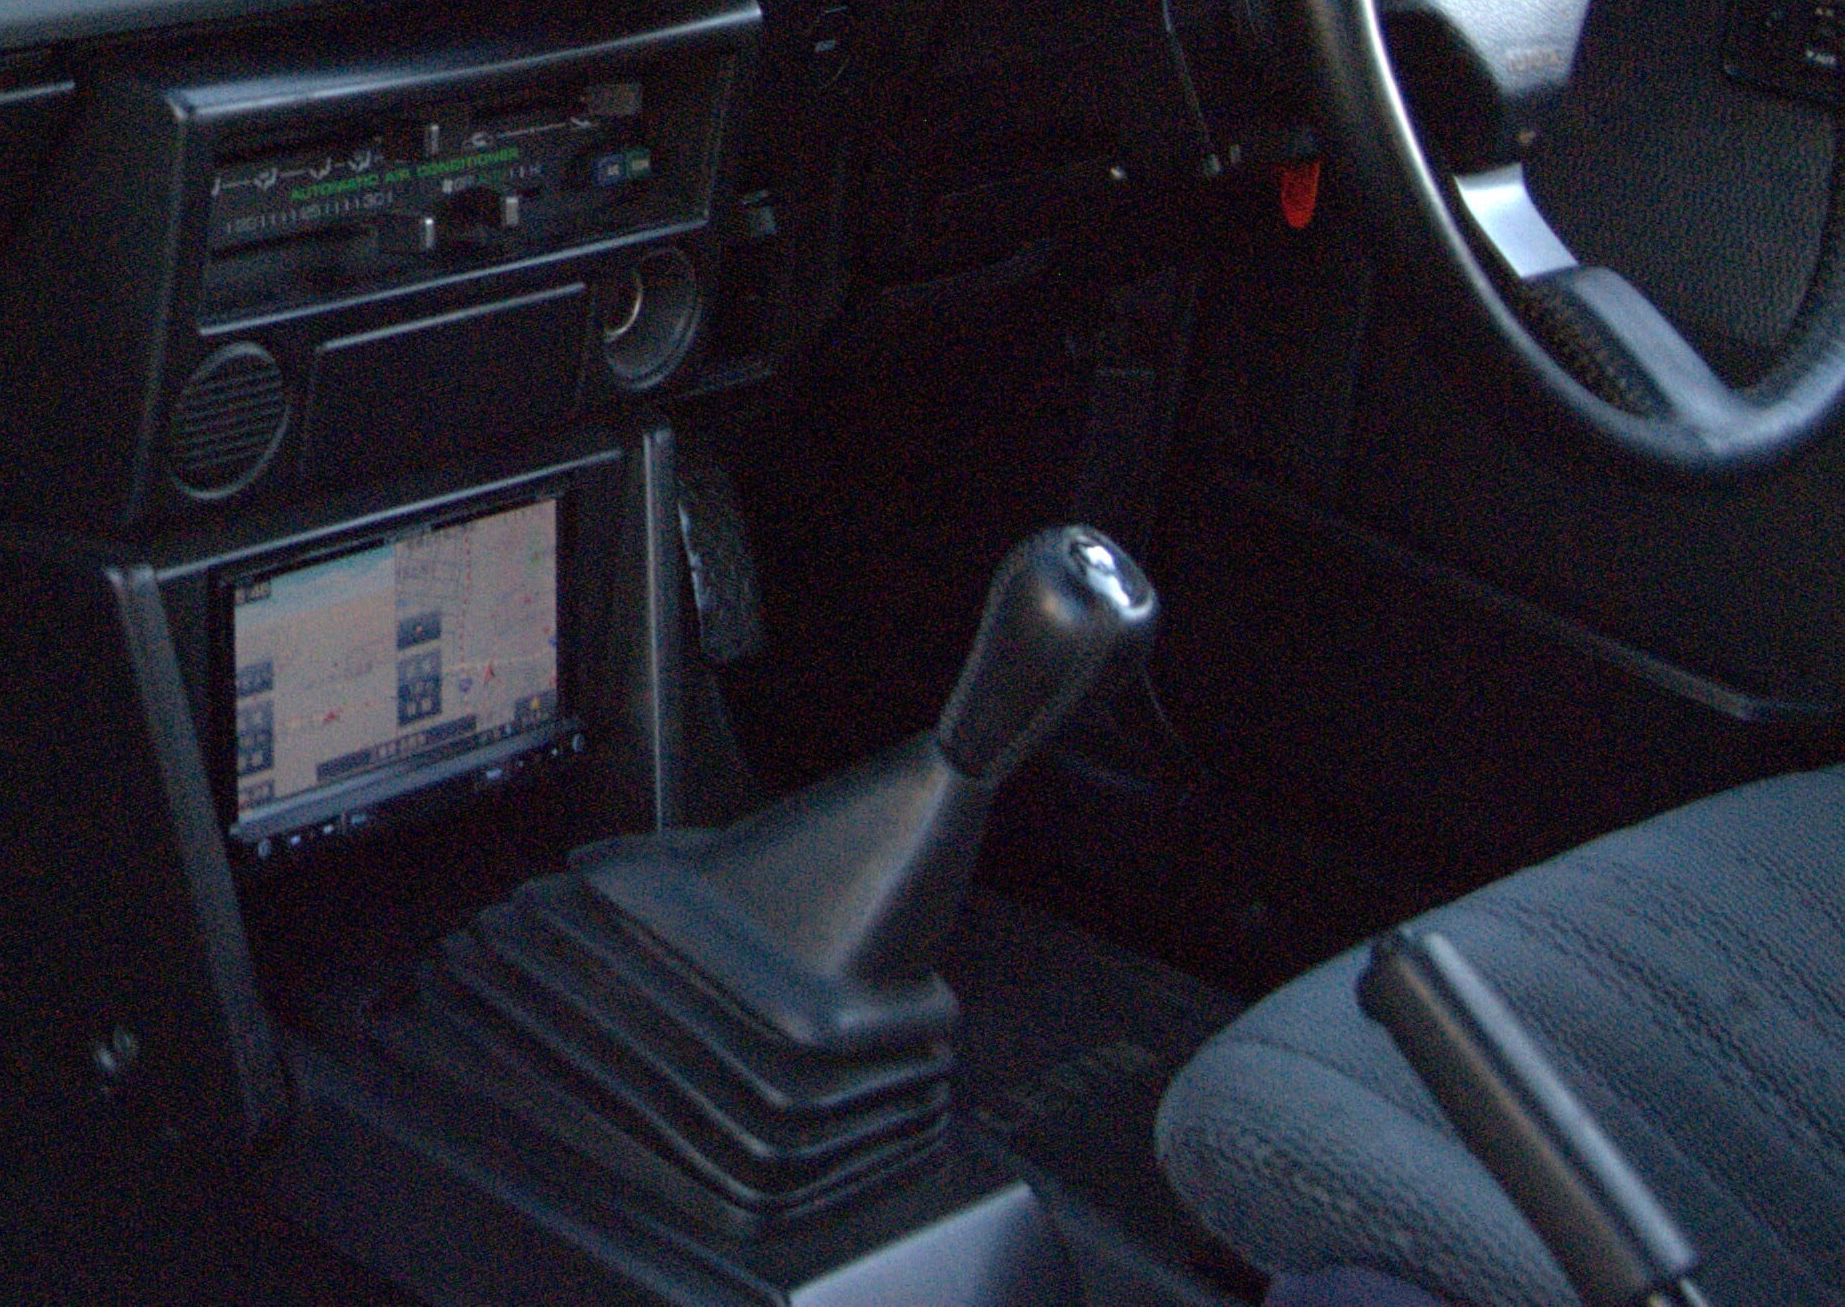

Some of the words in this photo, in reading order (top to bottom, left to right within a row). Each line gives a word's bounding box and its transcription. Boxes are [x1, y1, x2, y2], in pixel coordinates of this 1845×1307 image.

[289, 174, 380, 201] AUTOMATIC
[385, 167, 412, 184] AIR
[416, 148, 520, 178] CONDITIONER
